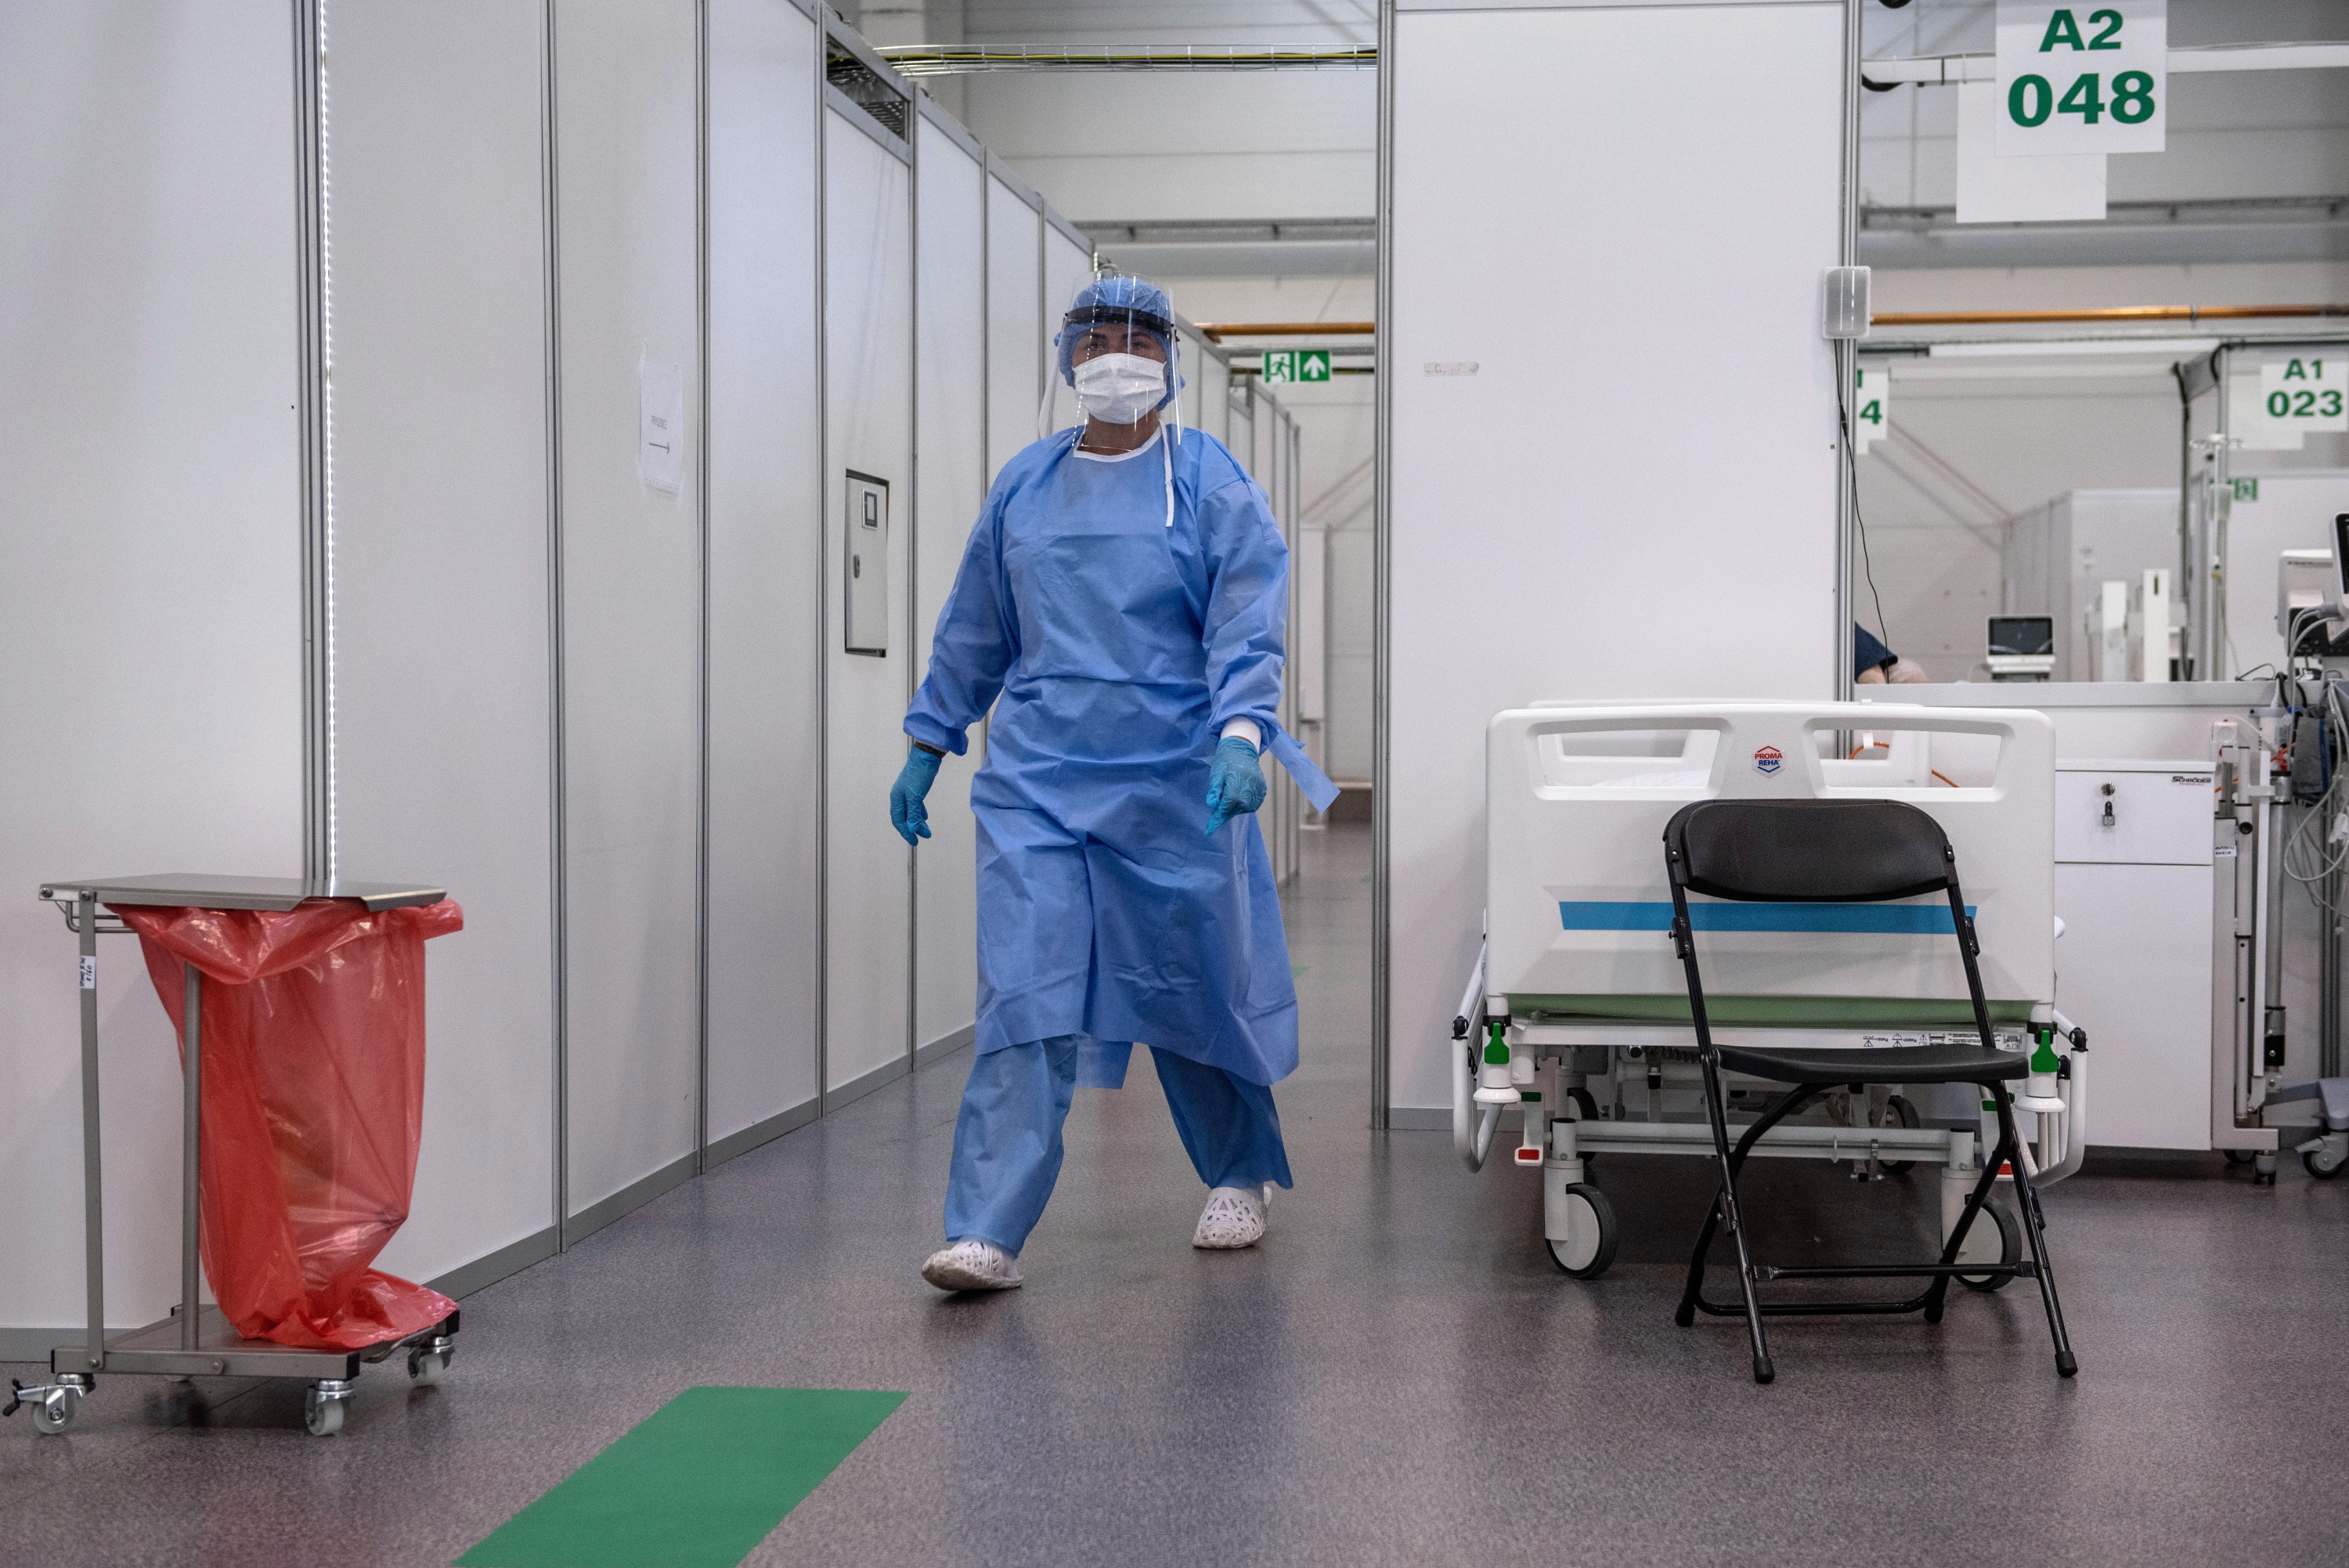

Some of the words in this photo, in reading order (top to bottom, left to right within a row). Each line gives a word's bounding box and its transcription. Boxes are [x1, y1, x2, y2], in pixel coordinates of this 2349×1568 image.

[2038, 9, 2123, 52] A2
[2008, 70, 2156, 128] 048
[2283, 359, 2322, 380] A1
[2267, 390, 2343, 417] 023
